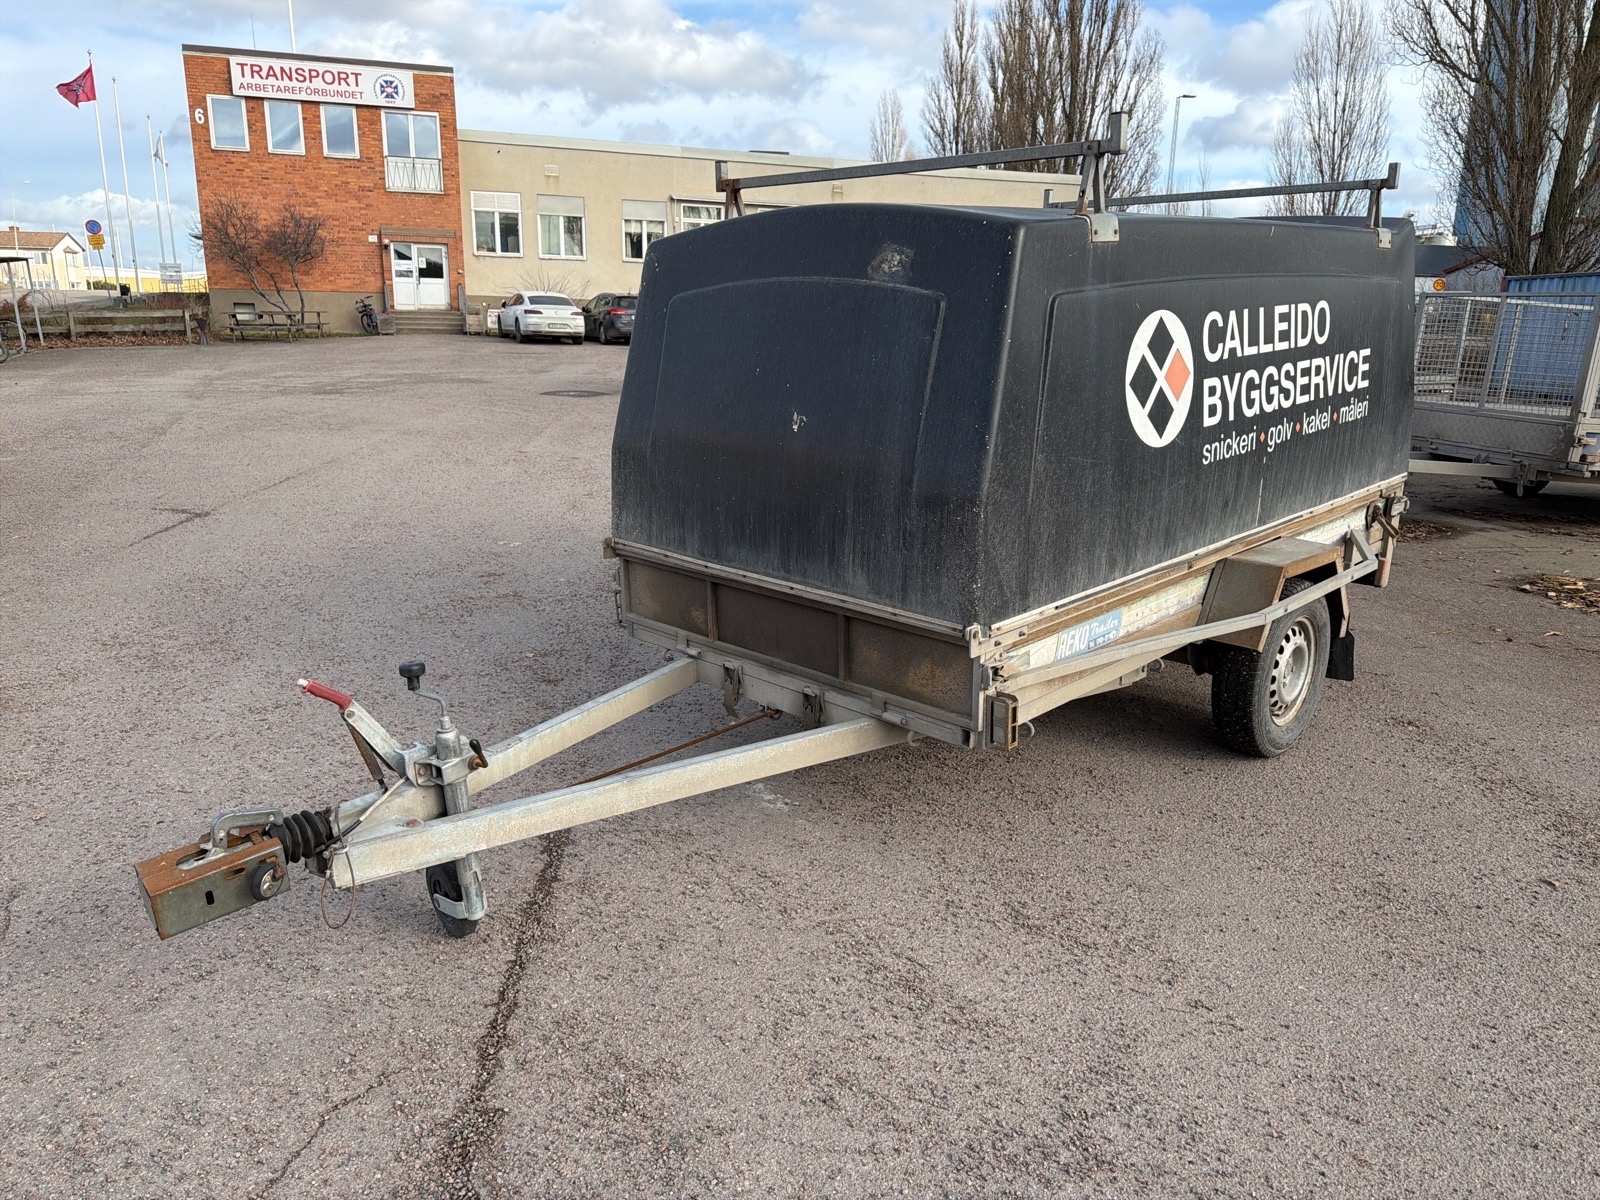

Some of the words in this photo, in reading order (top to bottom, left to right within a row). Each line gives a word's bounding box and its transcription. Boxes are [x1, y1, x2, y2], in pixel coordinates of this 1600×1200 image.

[236, 62, 363, 88] TRANSPORT
[238, 82, 365, 100] ARBETAREFÖRBUNDET
[194, 108, 205, 124] 6
[1203, 300, 1331, 363] CALLEIDO
[1203, 348, 1371, 428] BYGGSERVICE
[1202, 426, 1257, 465] snickeri
[1267, 418, 1294, 452] golv
[1302, 406, 1331, 436] kakel
[1339, 395, 1369, 424] måleri
